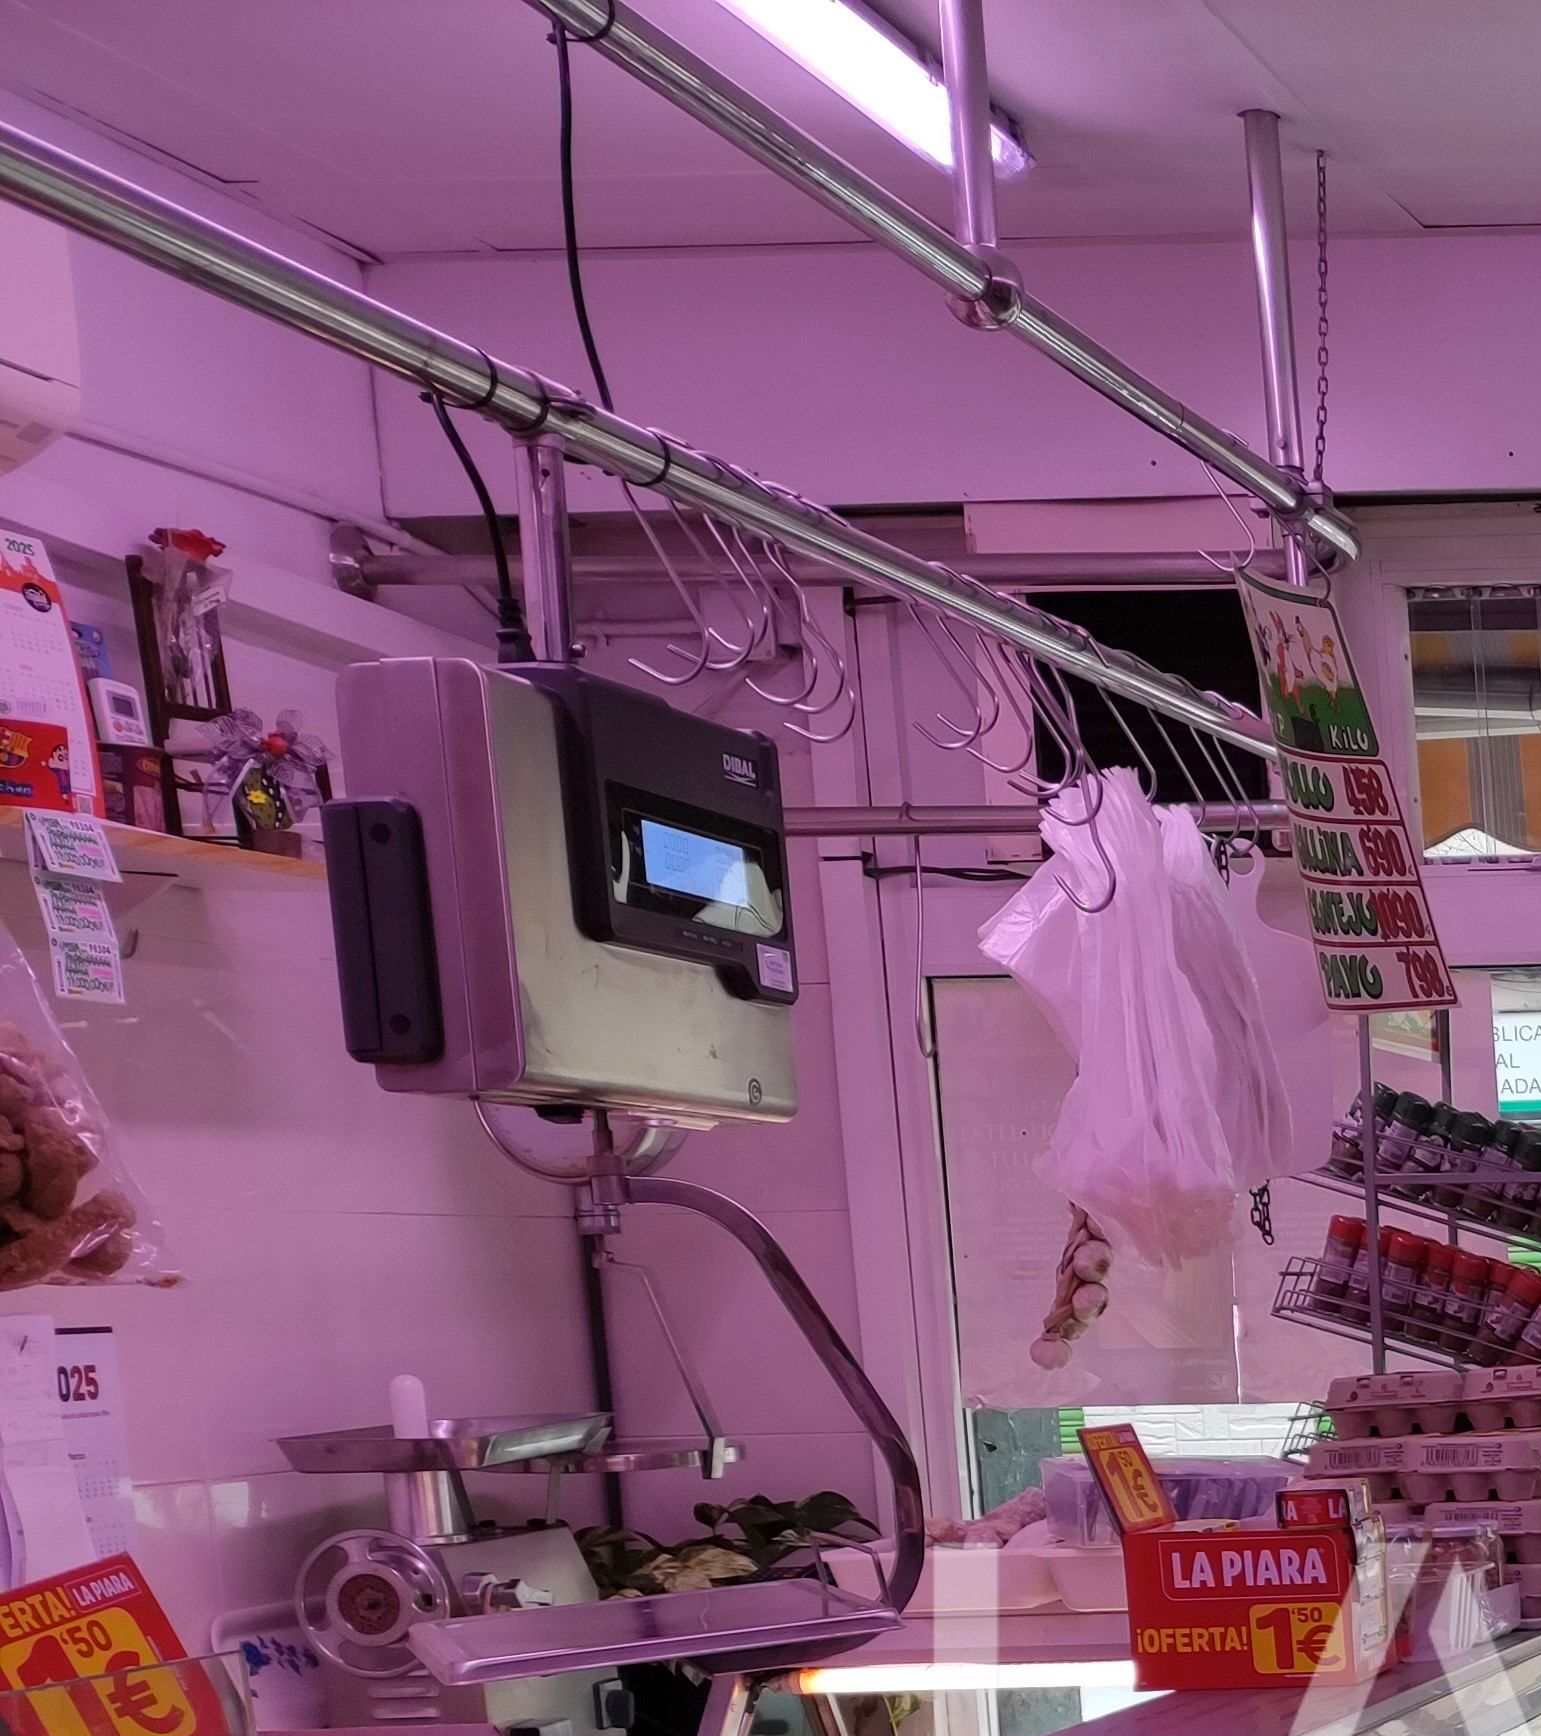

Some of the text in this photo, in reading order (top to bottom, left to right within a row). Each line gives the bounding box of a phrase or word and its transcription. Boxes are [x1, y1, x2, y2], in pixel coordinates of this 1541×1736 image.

[5, 538, 35, 557] 2025
[722, 753, 757, 780] DIBAL
[1319, 951, 1385, 1000] PAVO
[1172, 1547, 1327, 1590] LA PIARA
[72, 1572, 135, 1606] LA PIARA
[1136, 1625, 1248, 1655] ¡OFERTA!
